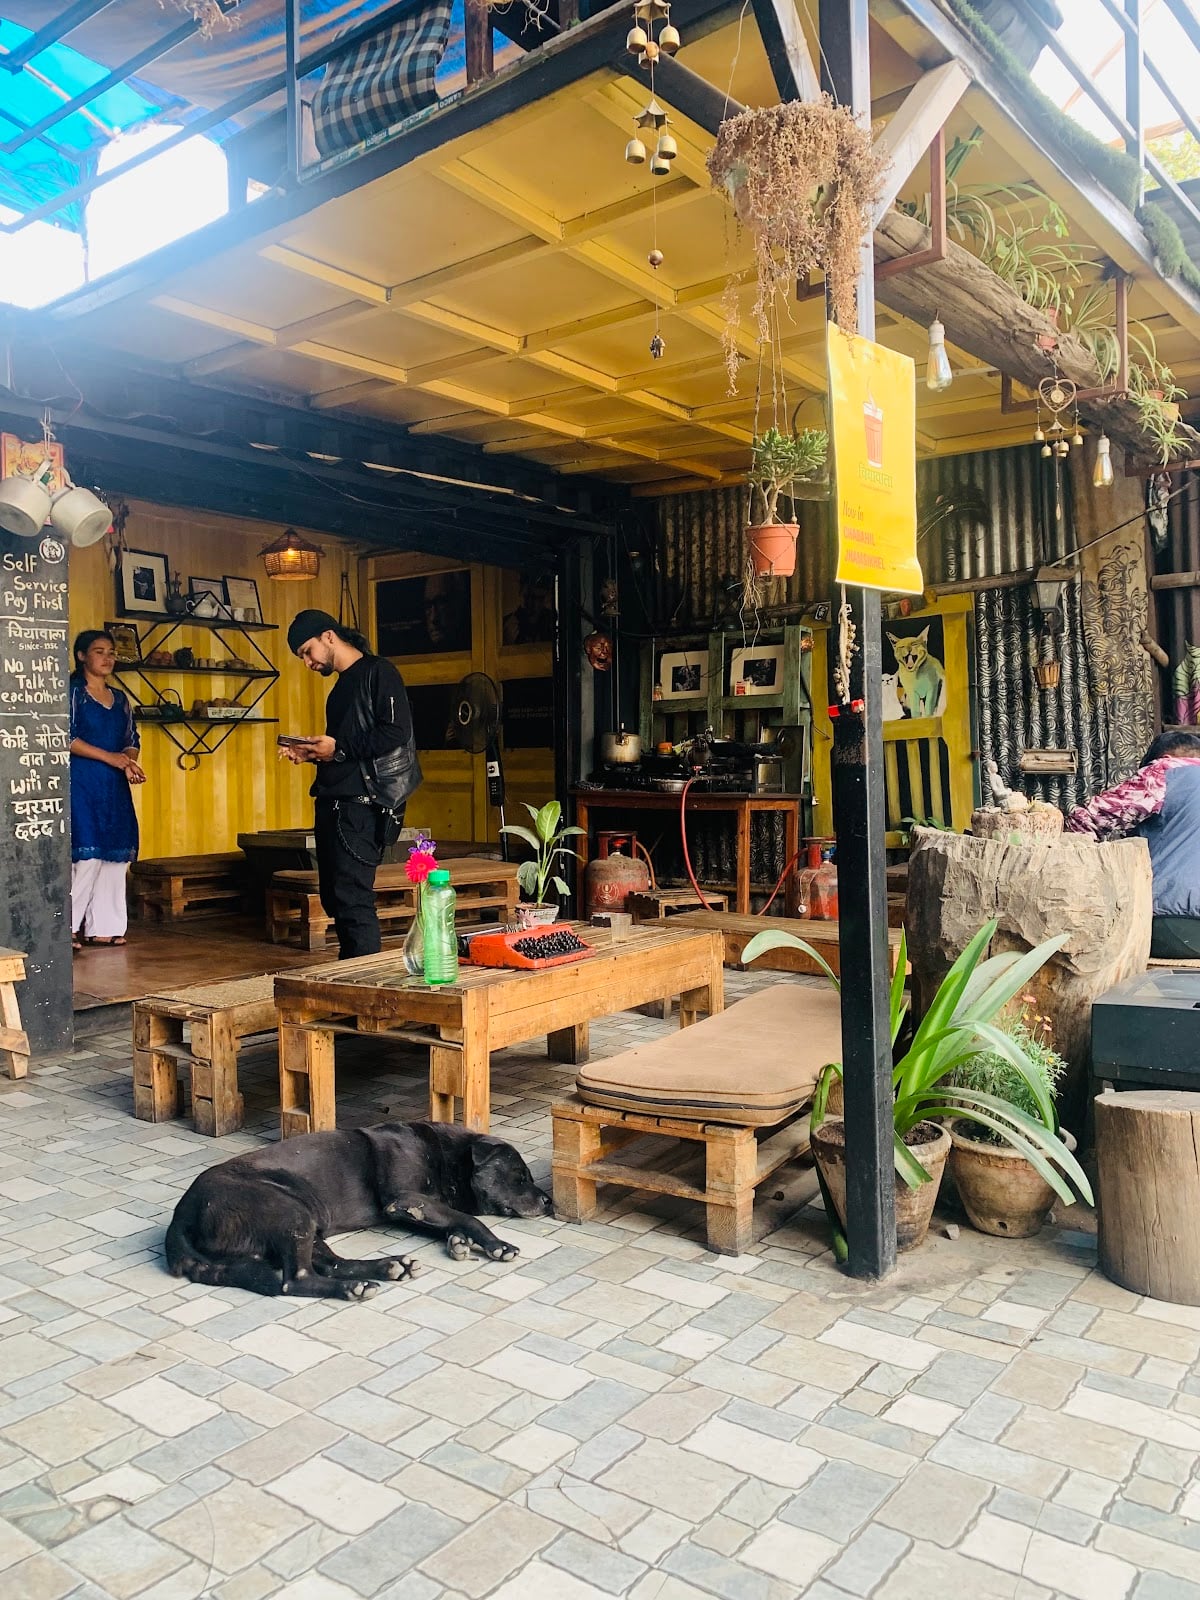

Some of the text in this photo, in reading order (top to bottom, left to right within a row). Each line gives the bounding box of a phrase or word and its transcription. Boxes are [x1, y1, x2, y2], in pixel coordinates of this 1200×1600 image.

[3, 553, 38, 573] Self
[14, 575, 68, 593] Service
[4, 591, 63, 614] Pay First
[5, 658, 24, 673] No
[15, 672, 65, 690] Talk to
[19, 752, 46, 767] बात
